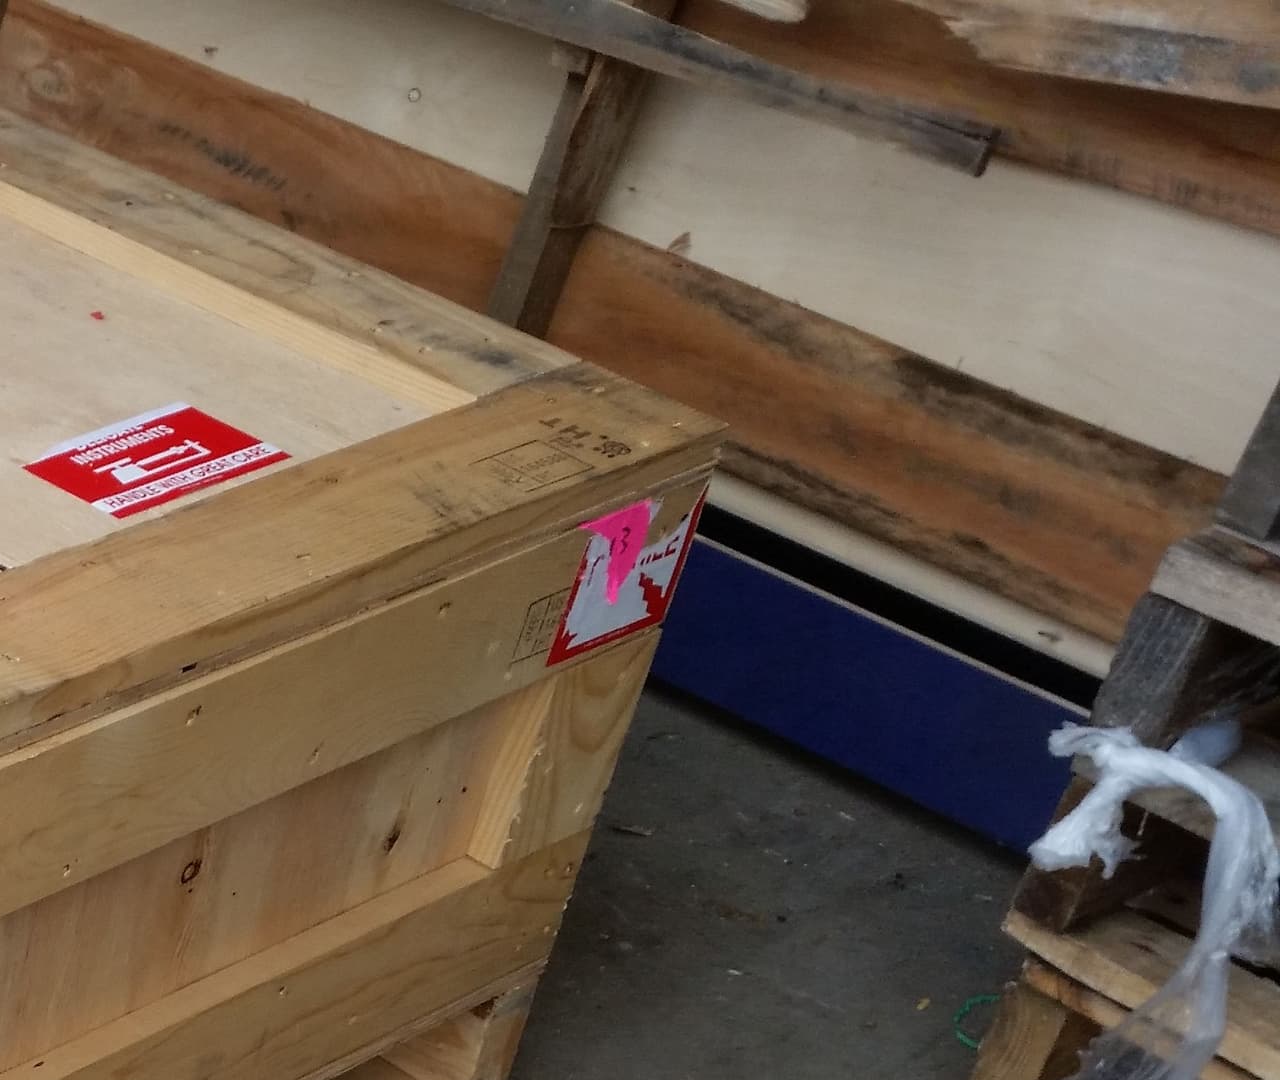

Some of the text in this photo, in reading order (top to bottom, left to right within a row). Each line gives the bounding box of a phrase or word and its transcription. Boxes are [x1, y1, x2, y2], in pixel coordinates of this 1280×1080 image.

[70, 424, 175, 466] INSTRUMENTS
[104, 486, 159, 508] HANDLE
[160, 473, 189, 491] WITH
[189, 458, 235, 478] GREAT
